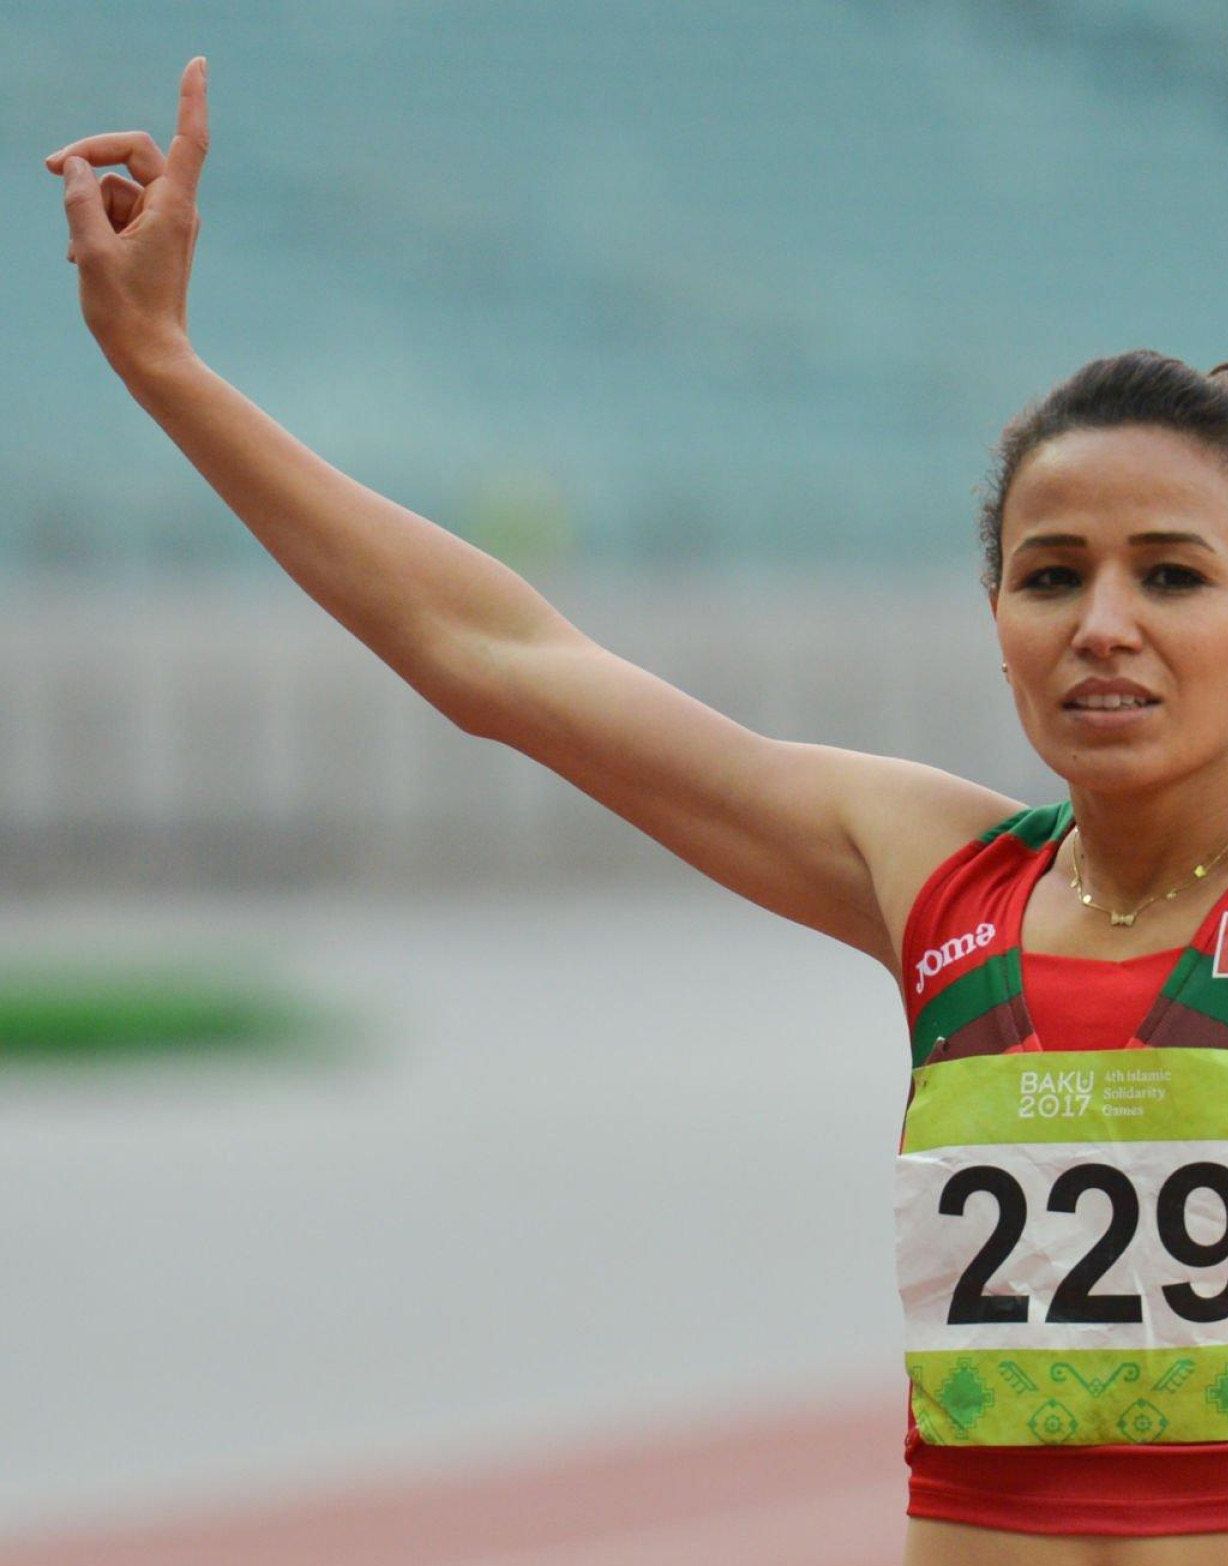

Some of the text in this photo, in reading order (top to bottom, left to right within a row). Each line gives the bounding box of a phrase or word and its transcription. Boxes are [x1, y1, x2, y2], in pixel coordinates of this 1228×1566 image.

[1020, 1071, 1094, 1094] BAKU
[1105, 1069, 1172, 1082] 4th Islamic
[1103, 1087, 1166, 1101] Solidarity
[1019, 1095, 1092, 1118] 2017
[1102, 1104, 1143, 1117] Games
